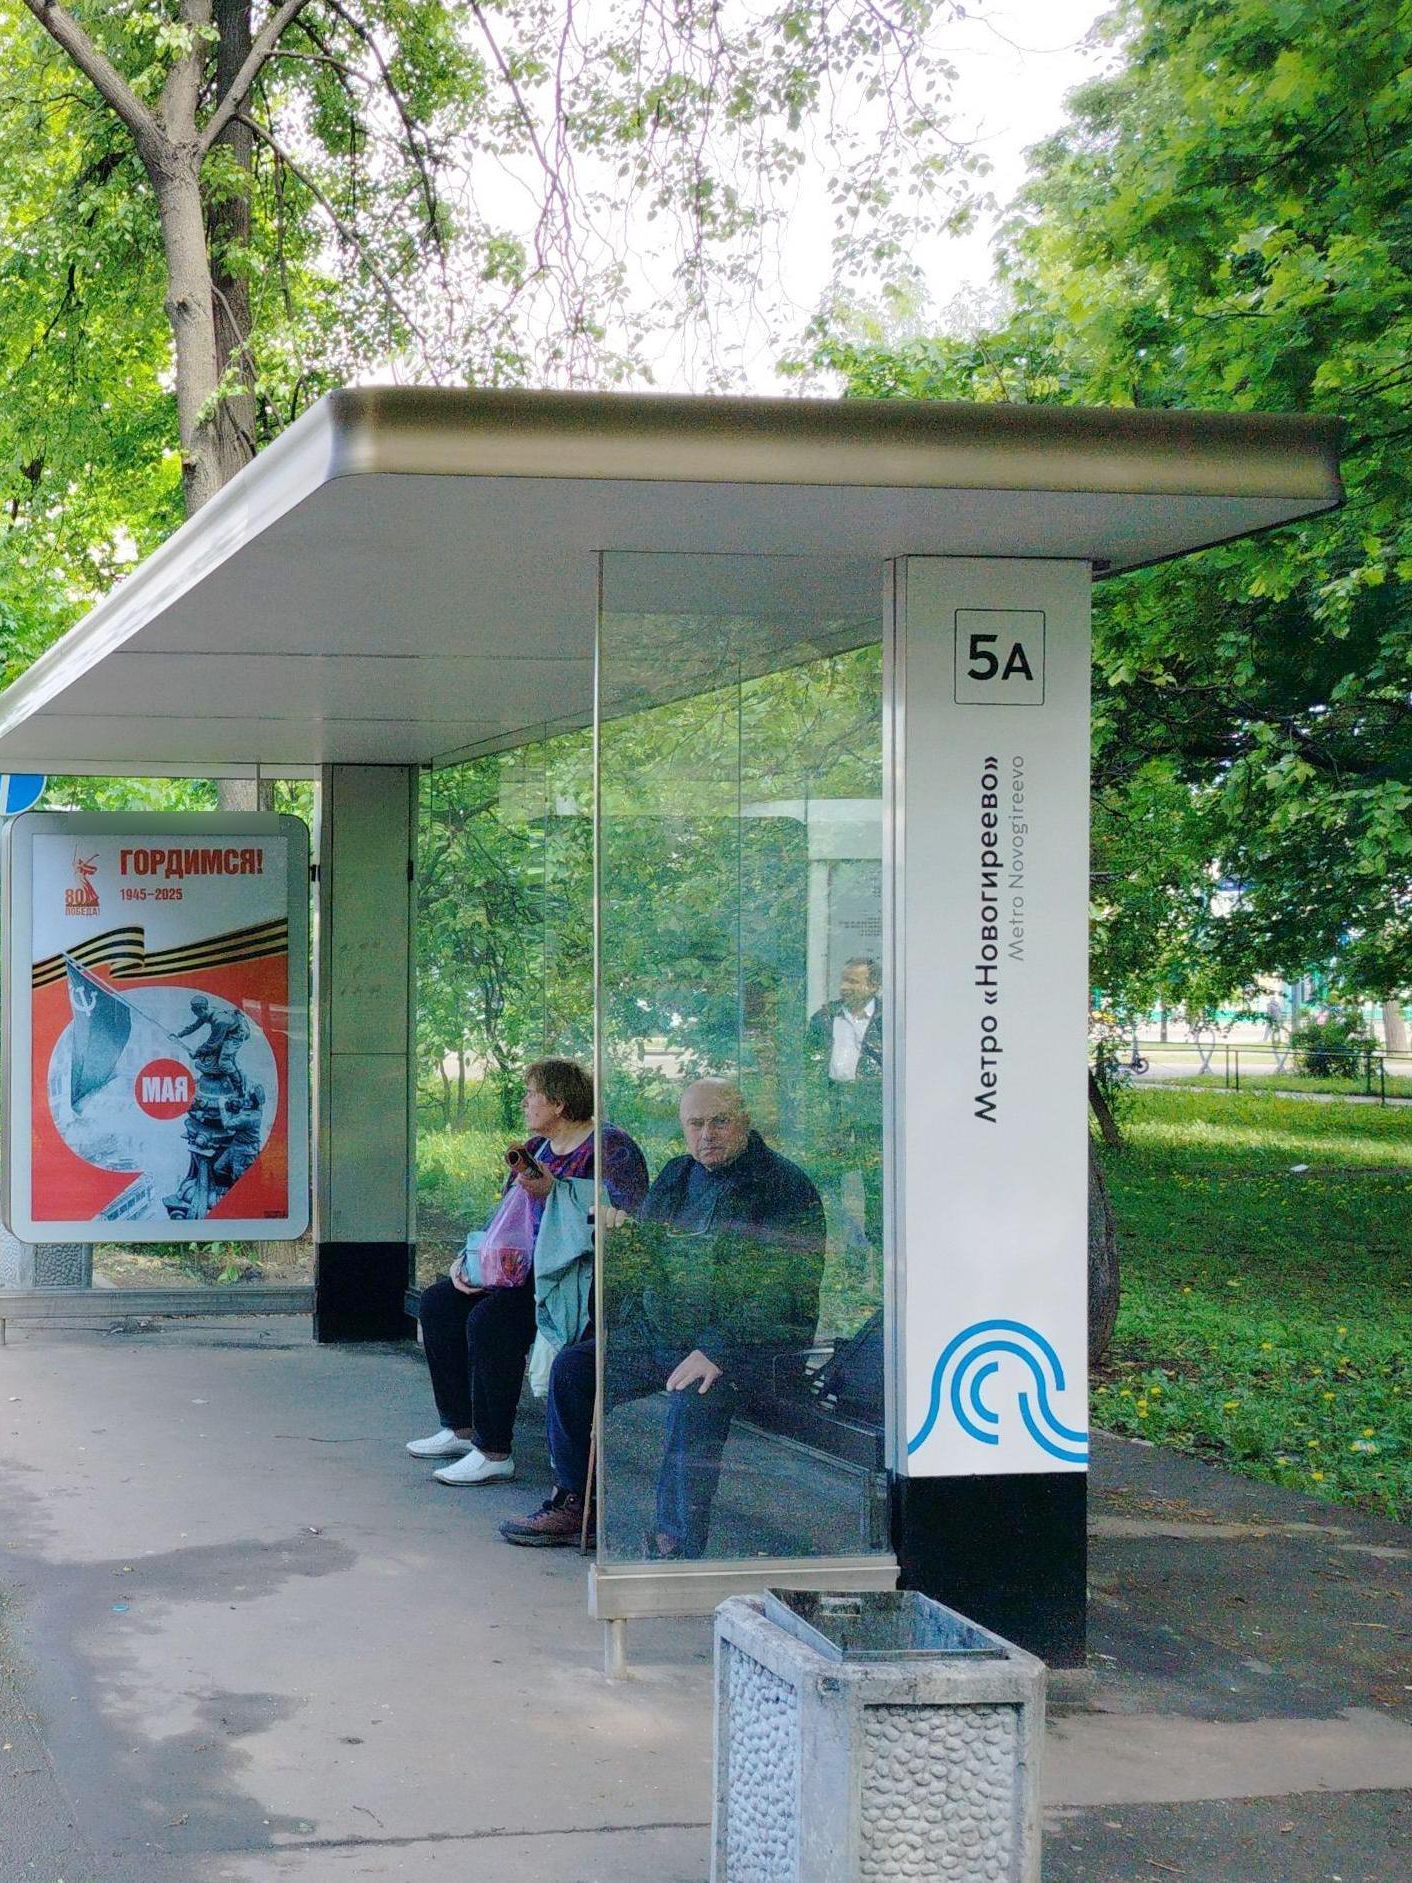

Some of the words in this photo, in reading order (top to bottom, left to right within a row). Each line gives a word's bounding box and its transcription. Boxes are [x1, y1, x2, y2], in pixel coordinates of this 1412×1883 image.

[1008, 755, 1029, 889] Novogireevo
[120, 848, 264, 879] ГОРДИМСЯ!
[975, 755, 1004, 1005] «Новогиреево»
[65, 888, 85, 904] 80
[65, 907, 101, 916] ПОБЕДА!
[1008, 896, 1025, 961] Metro
[142, 1076, 188, 1103] МАЯ
[974, 1015, 1003, 1124] Метро
